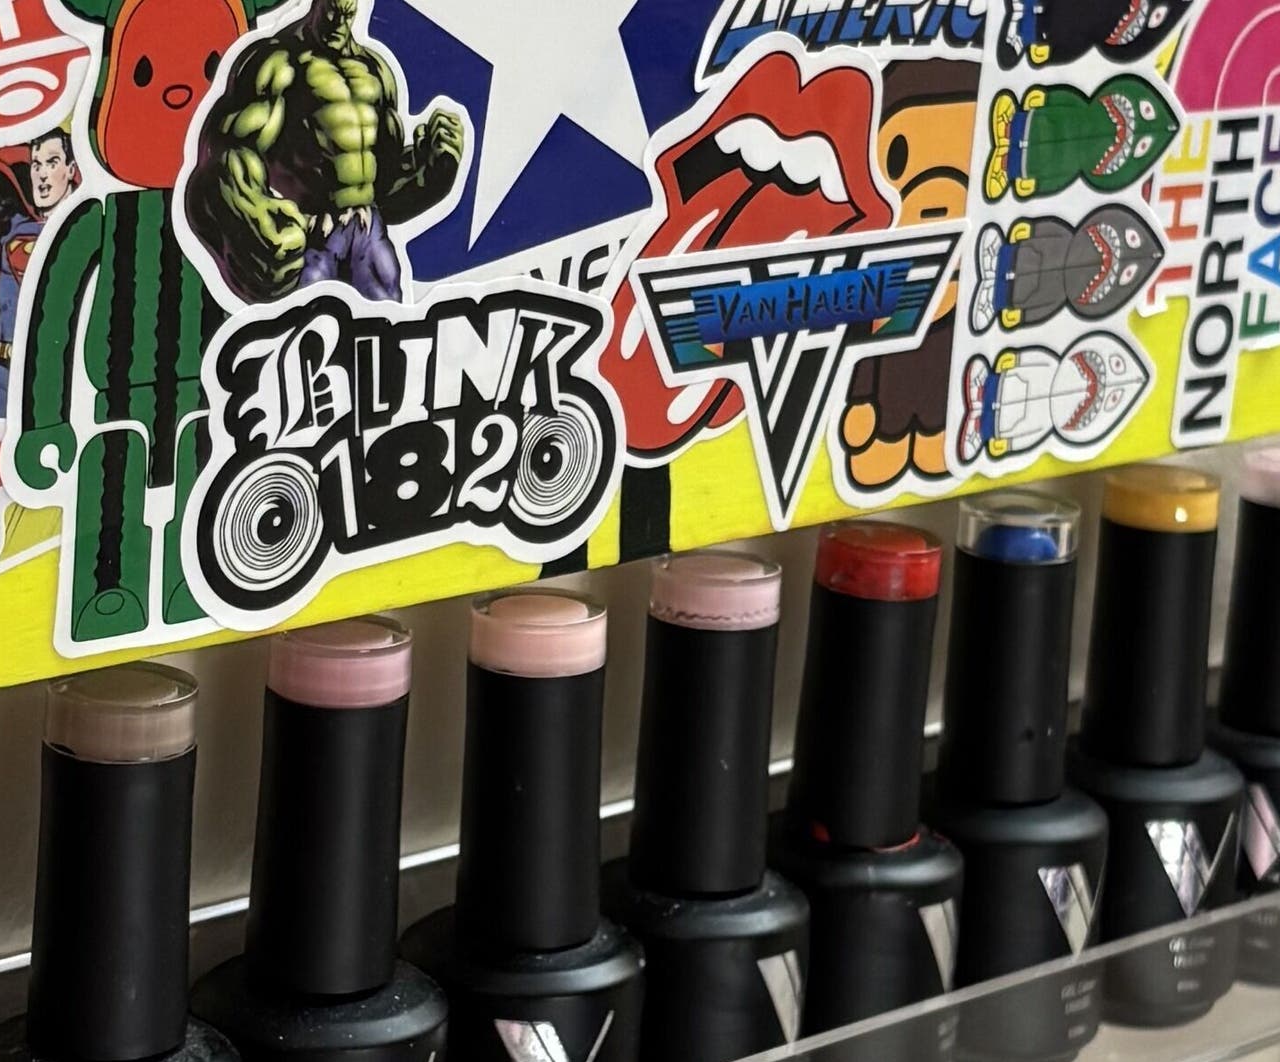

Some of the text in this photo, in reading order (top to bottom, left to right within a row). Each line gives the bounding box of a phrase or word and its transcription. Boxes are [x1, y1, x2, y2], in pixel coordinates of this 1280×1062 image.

[1146, 118, 1212, 306] THE
[1179, 115, 1260, 435] NORTH
[229, 306, 588, 448] BLINK
[717, 273, 886, 337] VAN HALEN
